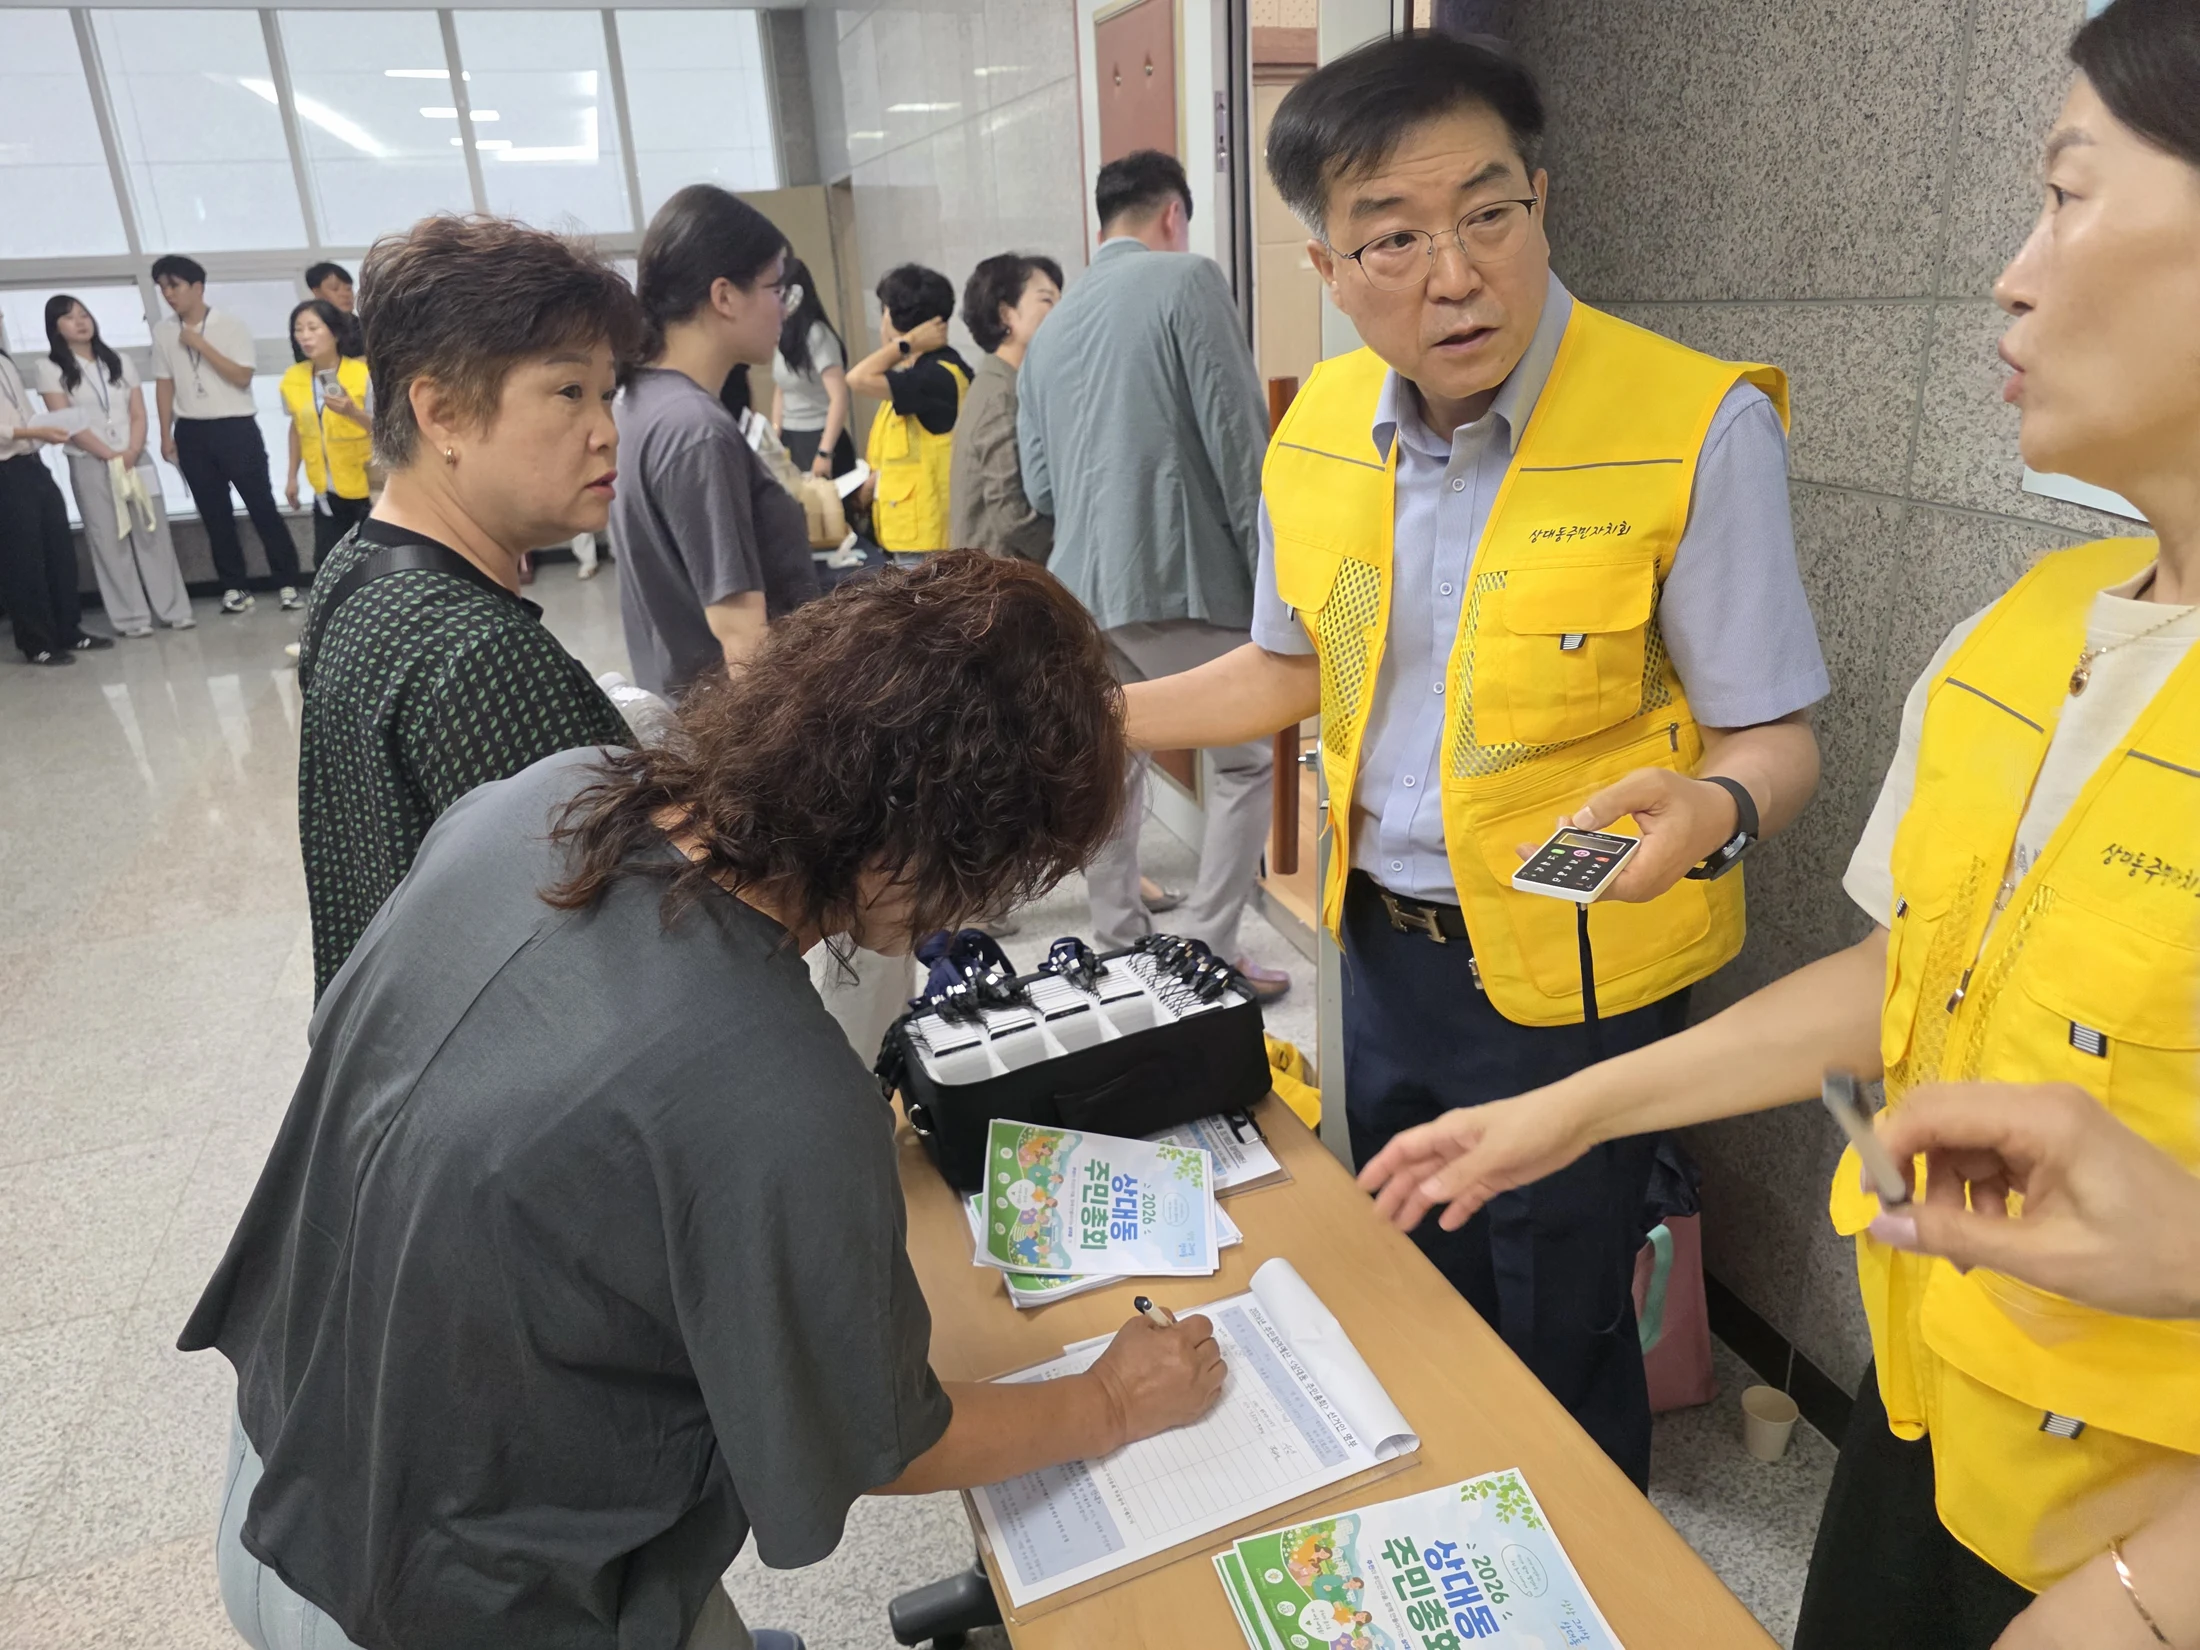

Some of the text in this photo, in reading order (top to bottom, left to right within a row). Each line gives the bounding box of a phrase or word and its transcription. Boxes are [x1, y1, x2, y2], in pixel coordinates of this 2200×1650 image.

[1528, 520, 1632, 544] 상대동주민자치회
[1081, 1159, 1109, 1249] 주민총회
[1111, 1174, 1137, 1241] 상대동
[1143, 1194, 1155, 1224] 2026
[1326, 1410, 1346, 1433] 선거인
[1341, 1431, 1358, 1449] 명부
[1424, 1541, 1499, 1639] 상대동
[1472, 1556, 1509, 1604] 2026
[1558, 1617, 1582, 1649] 상대동
